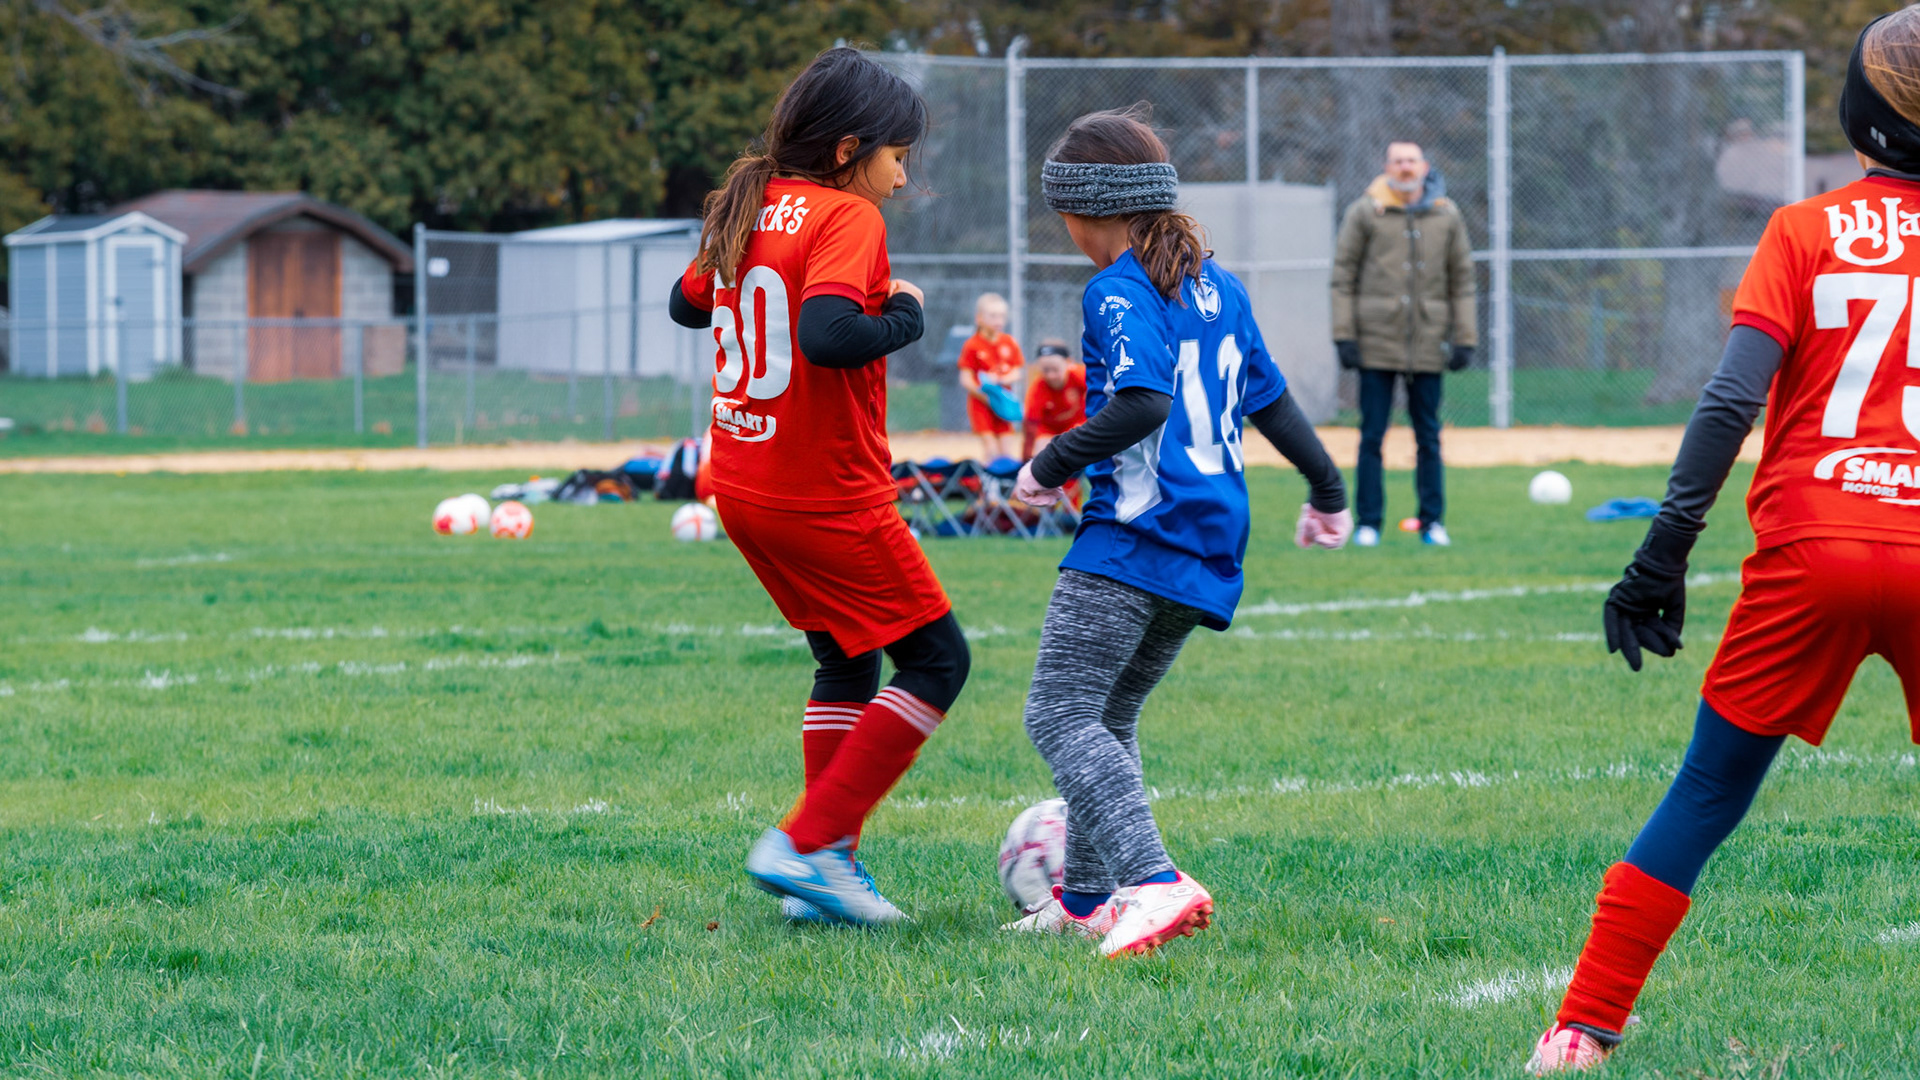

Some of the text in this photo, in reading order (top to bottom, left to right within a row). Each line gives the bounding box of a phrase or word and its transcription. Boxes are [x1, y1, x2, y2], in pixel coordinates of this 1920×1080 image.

[1813, 272, 1920, 442] 7
[715, 402, 763, 432] SMART
[1177, 333, 1244, 476] 12
[1841, 481, 1899, 497] MOTORS
